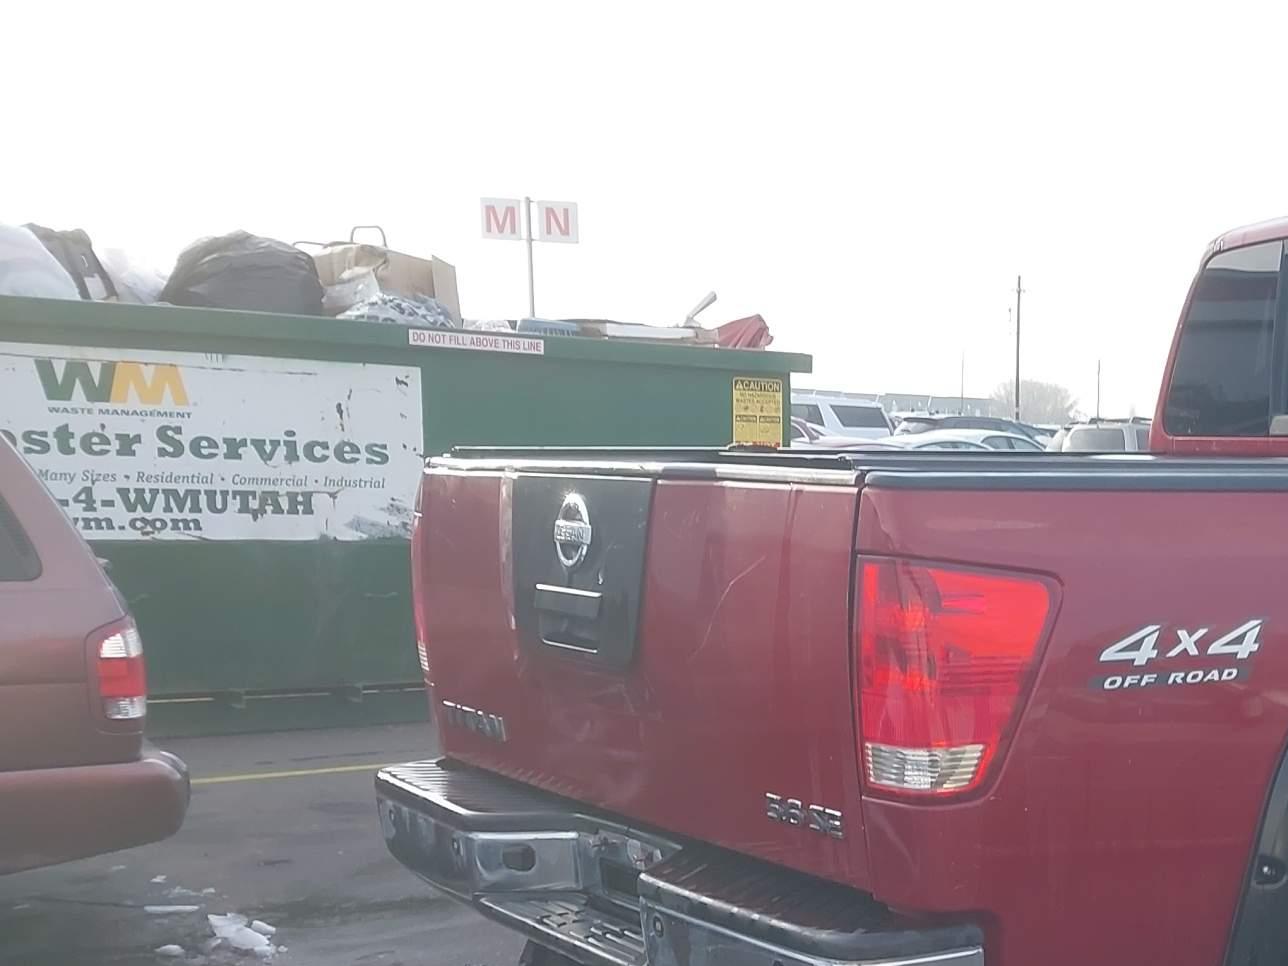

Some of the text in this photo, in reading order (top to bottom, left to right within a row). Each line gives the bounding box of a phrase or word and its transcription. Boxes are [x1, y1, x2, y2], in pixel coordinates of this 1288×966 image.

[485, 204, 517, 235] M
[545, 206, 570, 237] N
[412, 331, 542, 353] DO NOT FILL ABOVE THIS LINE
[34, 359, 190, 407] WM
[743, 380, 780, 392] CAUTION
[48, 406, 192, 420] WASTE MANAGEMENT
[156, 424, 390, 466] Services
[81, 469, 117, 483] Sizes
[136, 471, 214, 485] Residential
[231, 473, 308, 487] Commercial
[323, 475, 386, 489] Industrial
[1103, 667, 1238, 690] OFF ROAD
